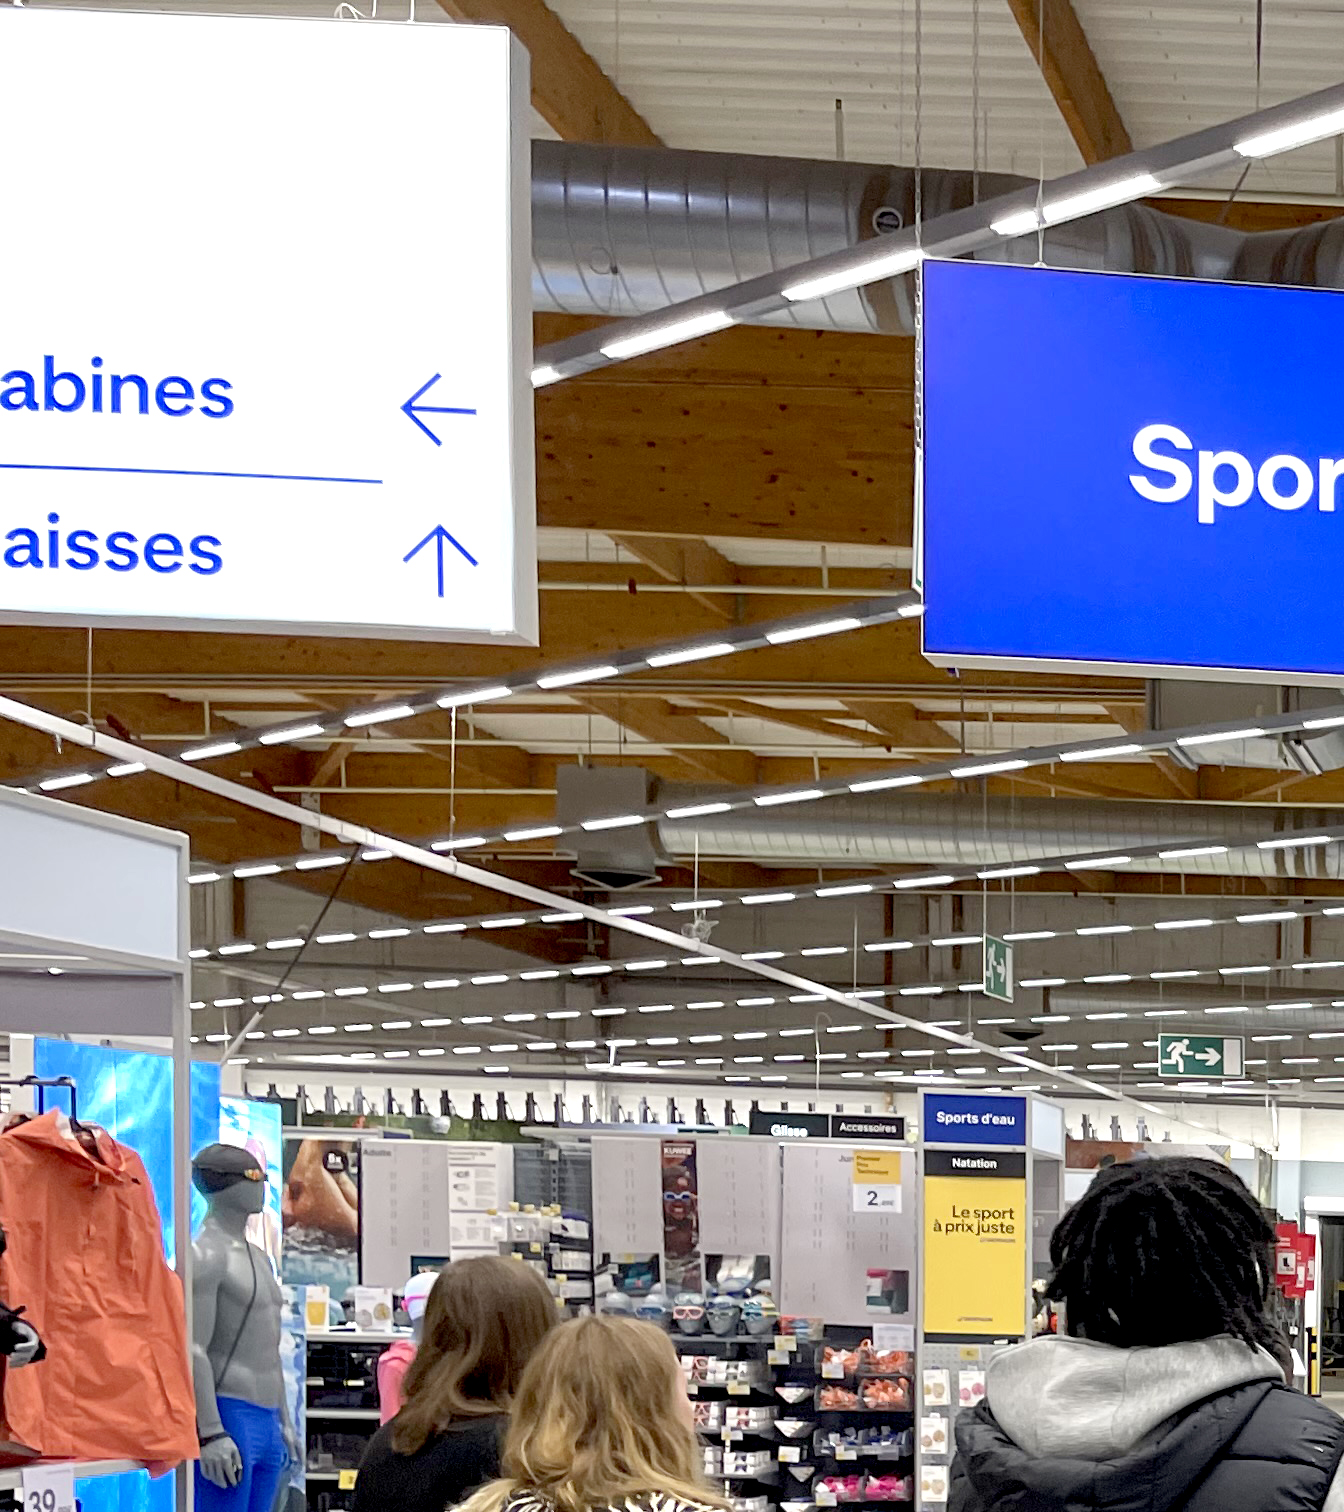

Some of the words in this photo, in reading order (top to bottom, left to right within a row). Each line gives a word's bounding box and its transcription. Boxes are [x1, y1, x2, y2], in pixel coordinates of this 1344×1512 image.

[0, 354, 235, 419] abines
[2, 511, 224, 576] aisses
[936, 1111, 979, 1126] Sports
[981, 1113, 1016, 1126] d'eau
[770, 1123, 808, 1137] Glisse
[839, 1122, 897, 1134] Accessoires
[951, 1157, 998, 1170] Natation
[952, 1204, 971, 1219] Le
[973, 1207, 1015, 1222] sport
[933, 1218, 943, 1233] à
[945, 1218, 975, 1236] prix
[975, 1218, 1015, 1236] juste
